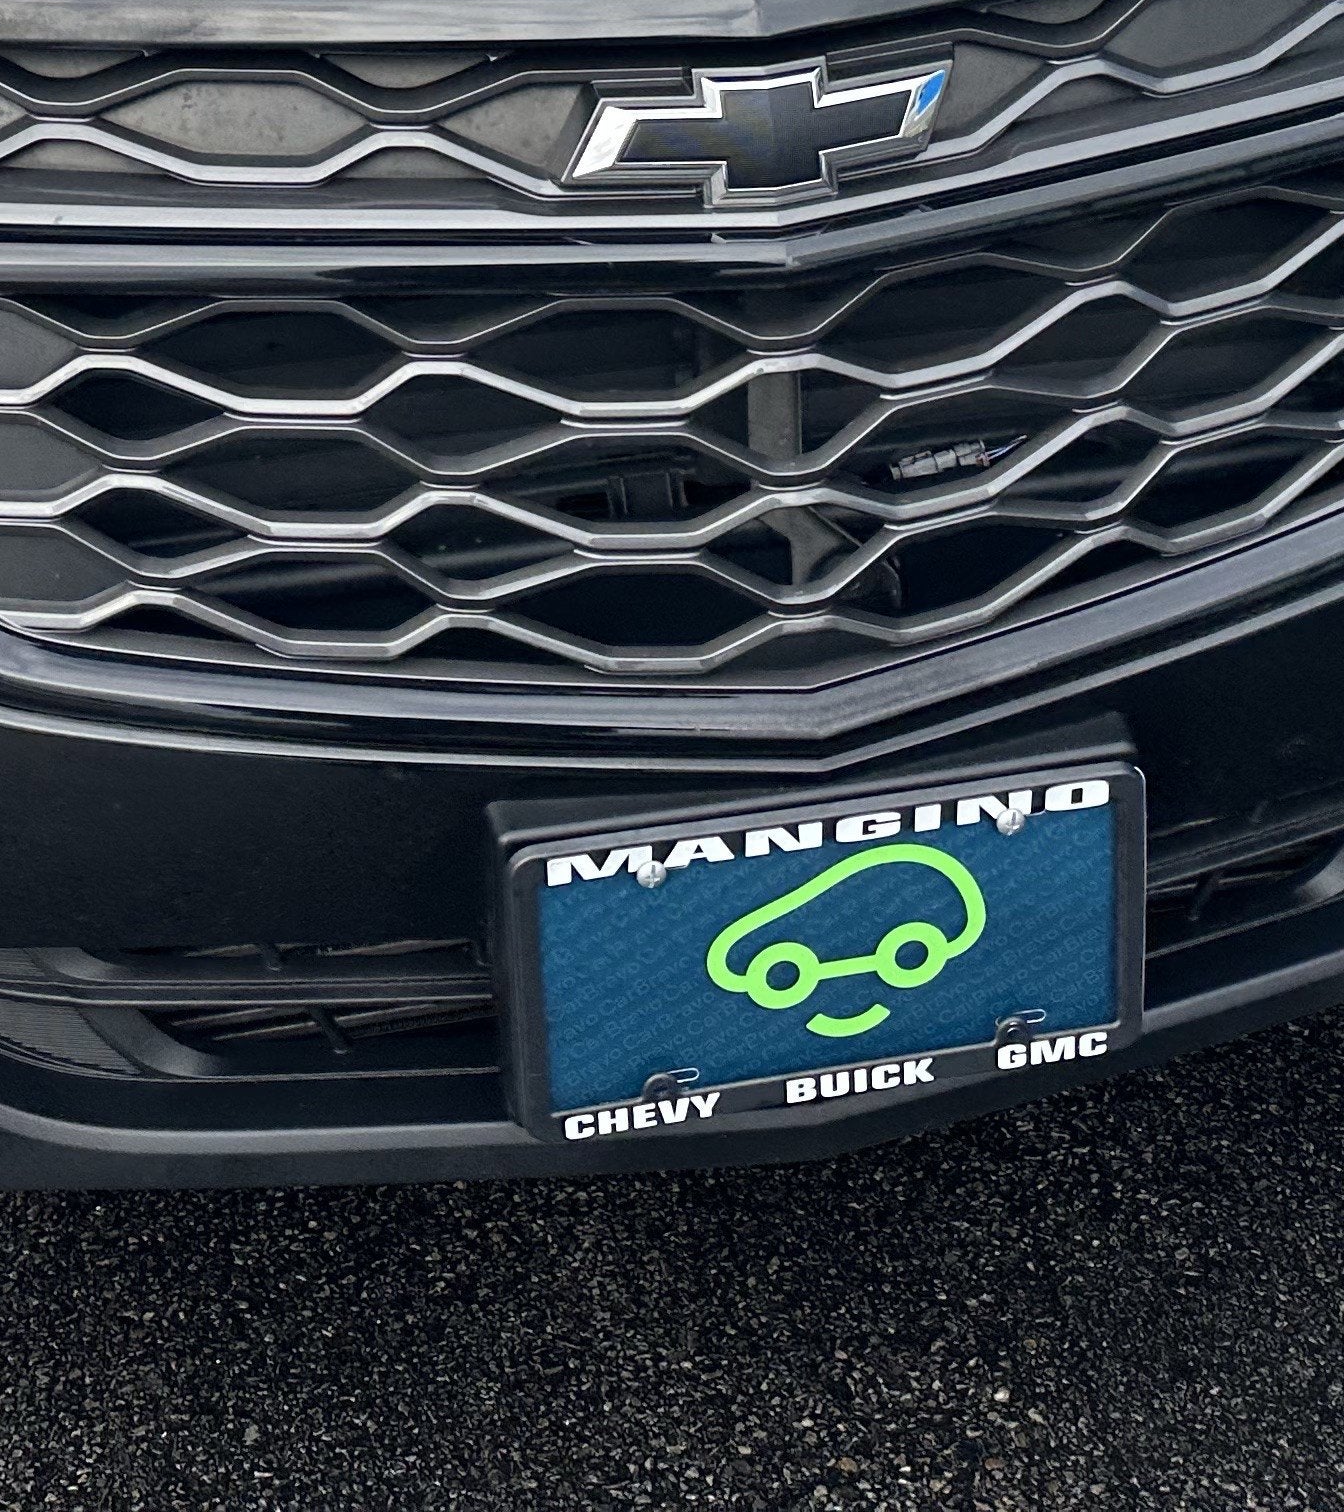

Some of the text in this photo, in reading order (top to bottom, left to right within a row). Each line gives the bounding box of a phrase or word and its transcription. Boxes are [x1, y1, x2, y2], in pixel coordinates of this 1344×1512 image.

[546, 779, 1111, 886] MANGINO
[563, 1031, 1109, 1141] CHEVY BUICK GMC
